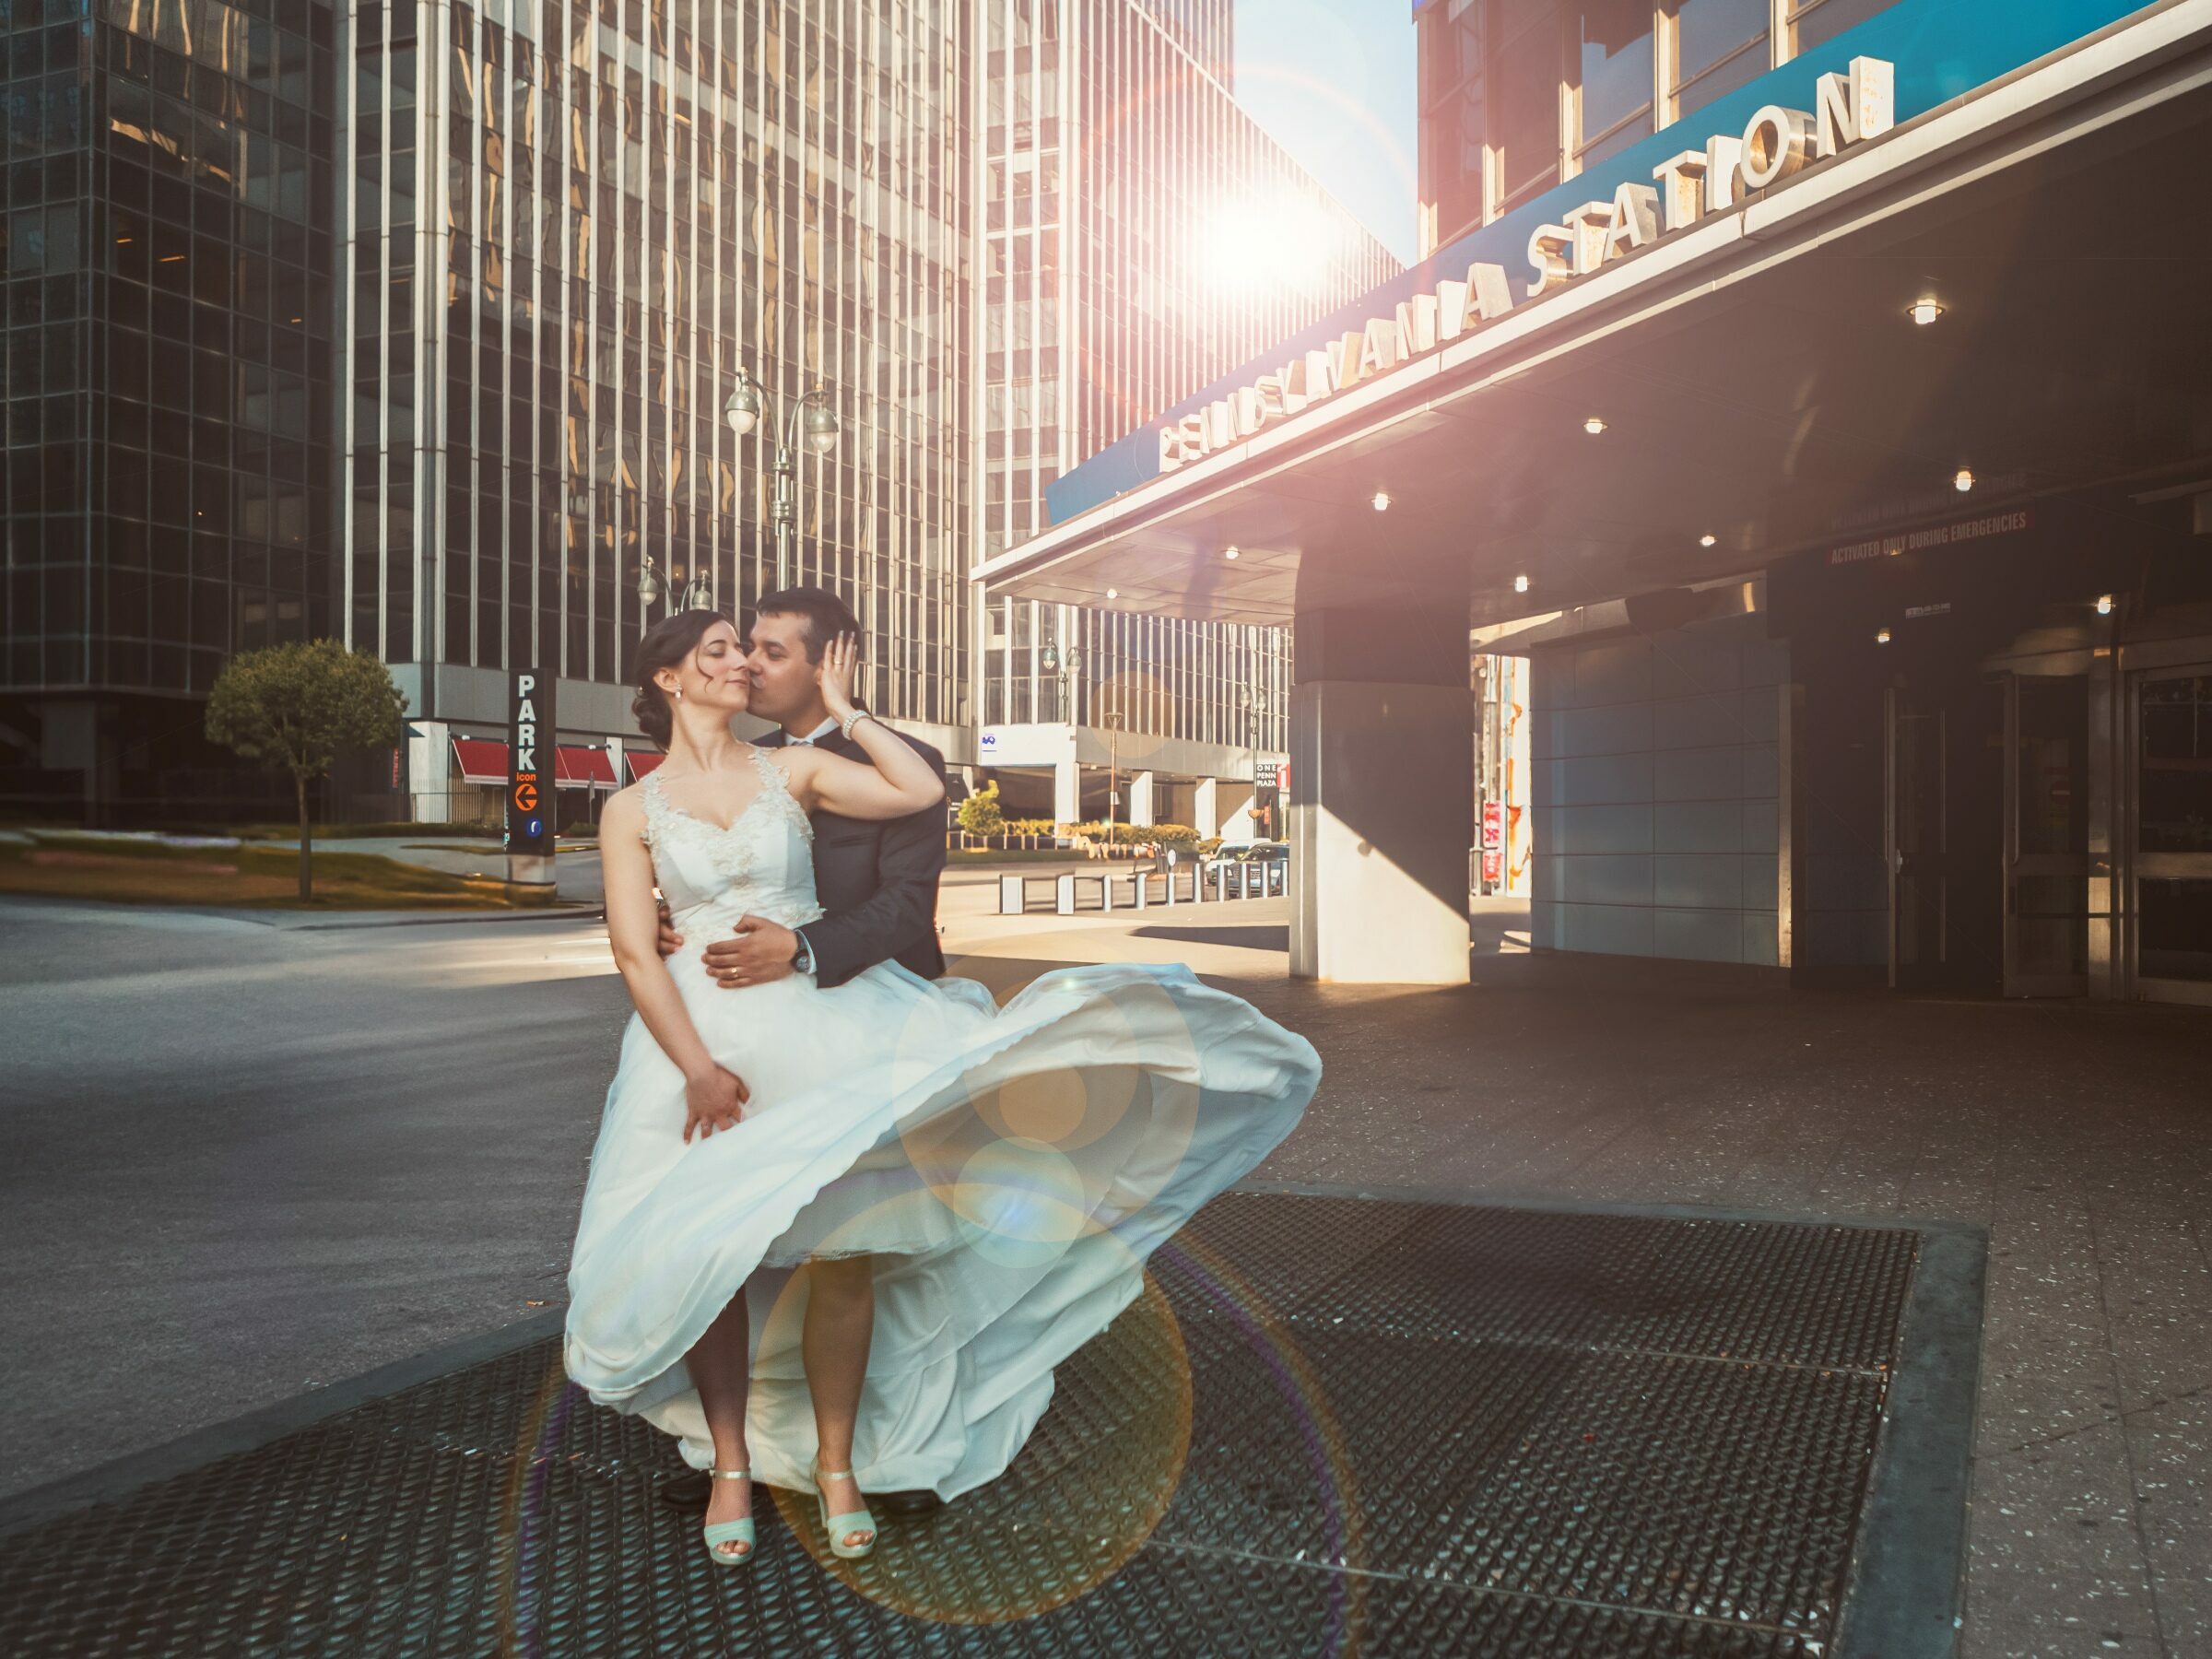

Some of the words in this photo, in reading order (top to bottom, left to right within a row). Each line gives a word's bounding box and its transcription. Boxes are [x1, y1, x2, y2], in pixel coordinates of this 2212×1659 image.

[1159, 262, 1514, 473] PENNSYLVANIA
[1527, 55, 1894, 298] STATION
[1831, 541, 1879, 564] ACTIVATED
[1883, 535, 1906, 555] ONLY
[1909, 527, 1948, 549] DURING
[1951, 512, 2026, 541] EMERGENCIES
[518, 675, 536, 771] PARK
[516, 772, 536, 782] icon
